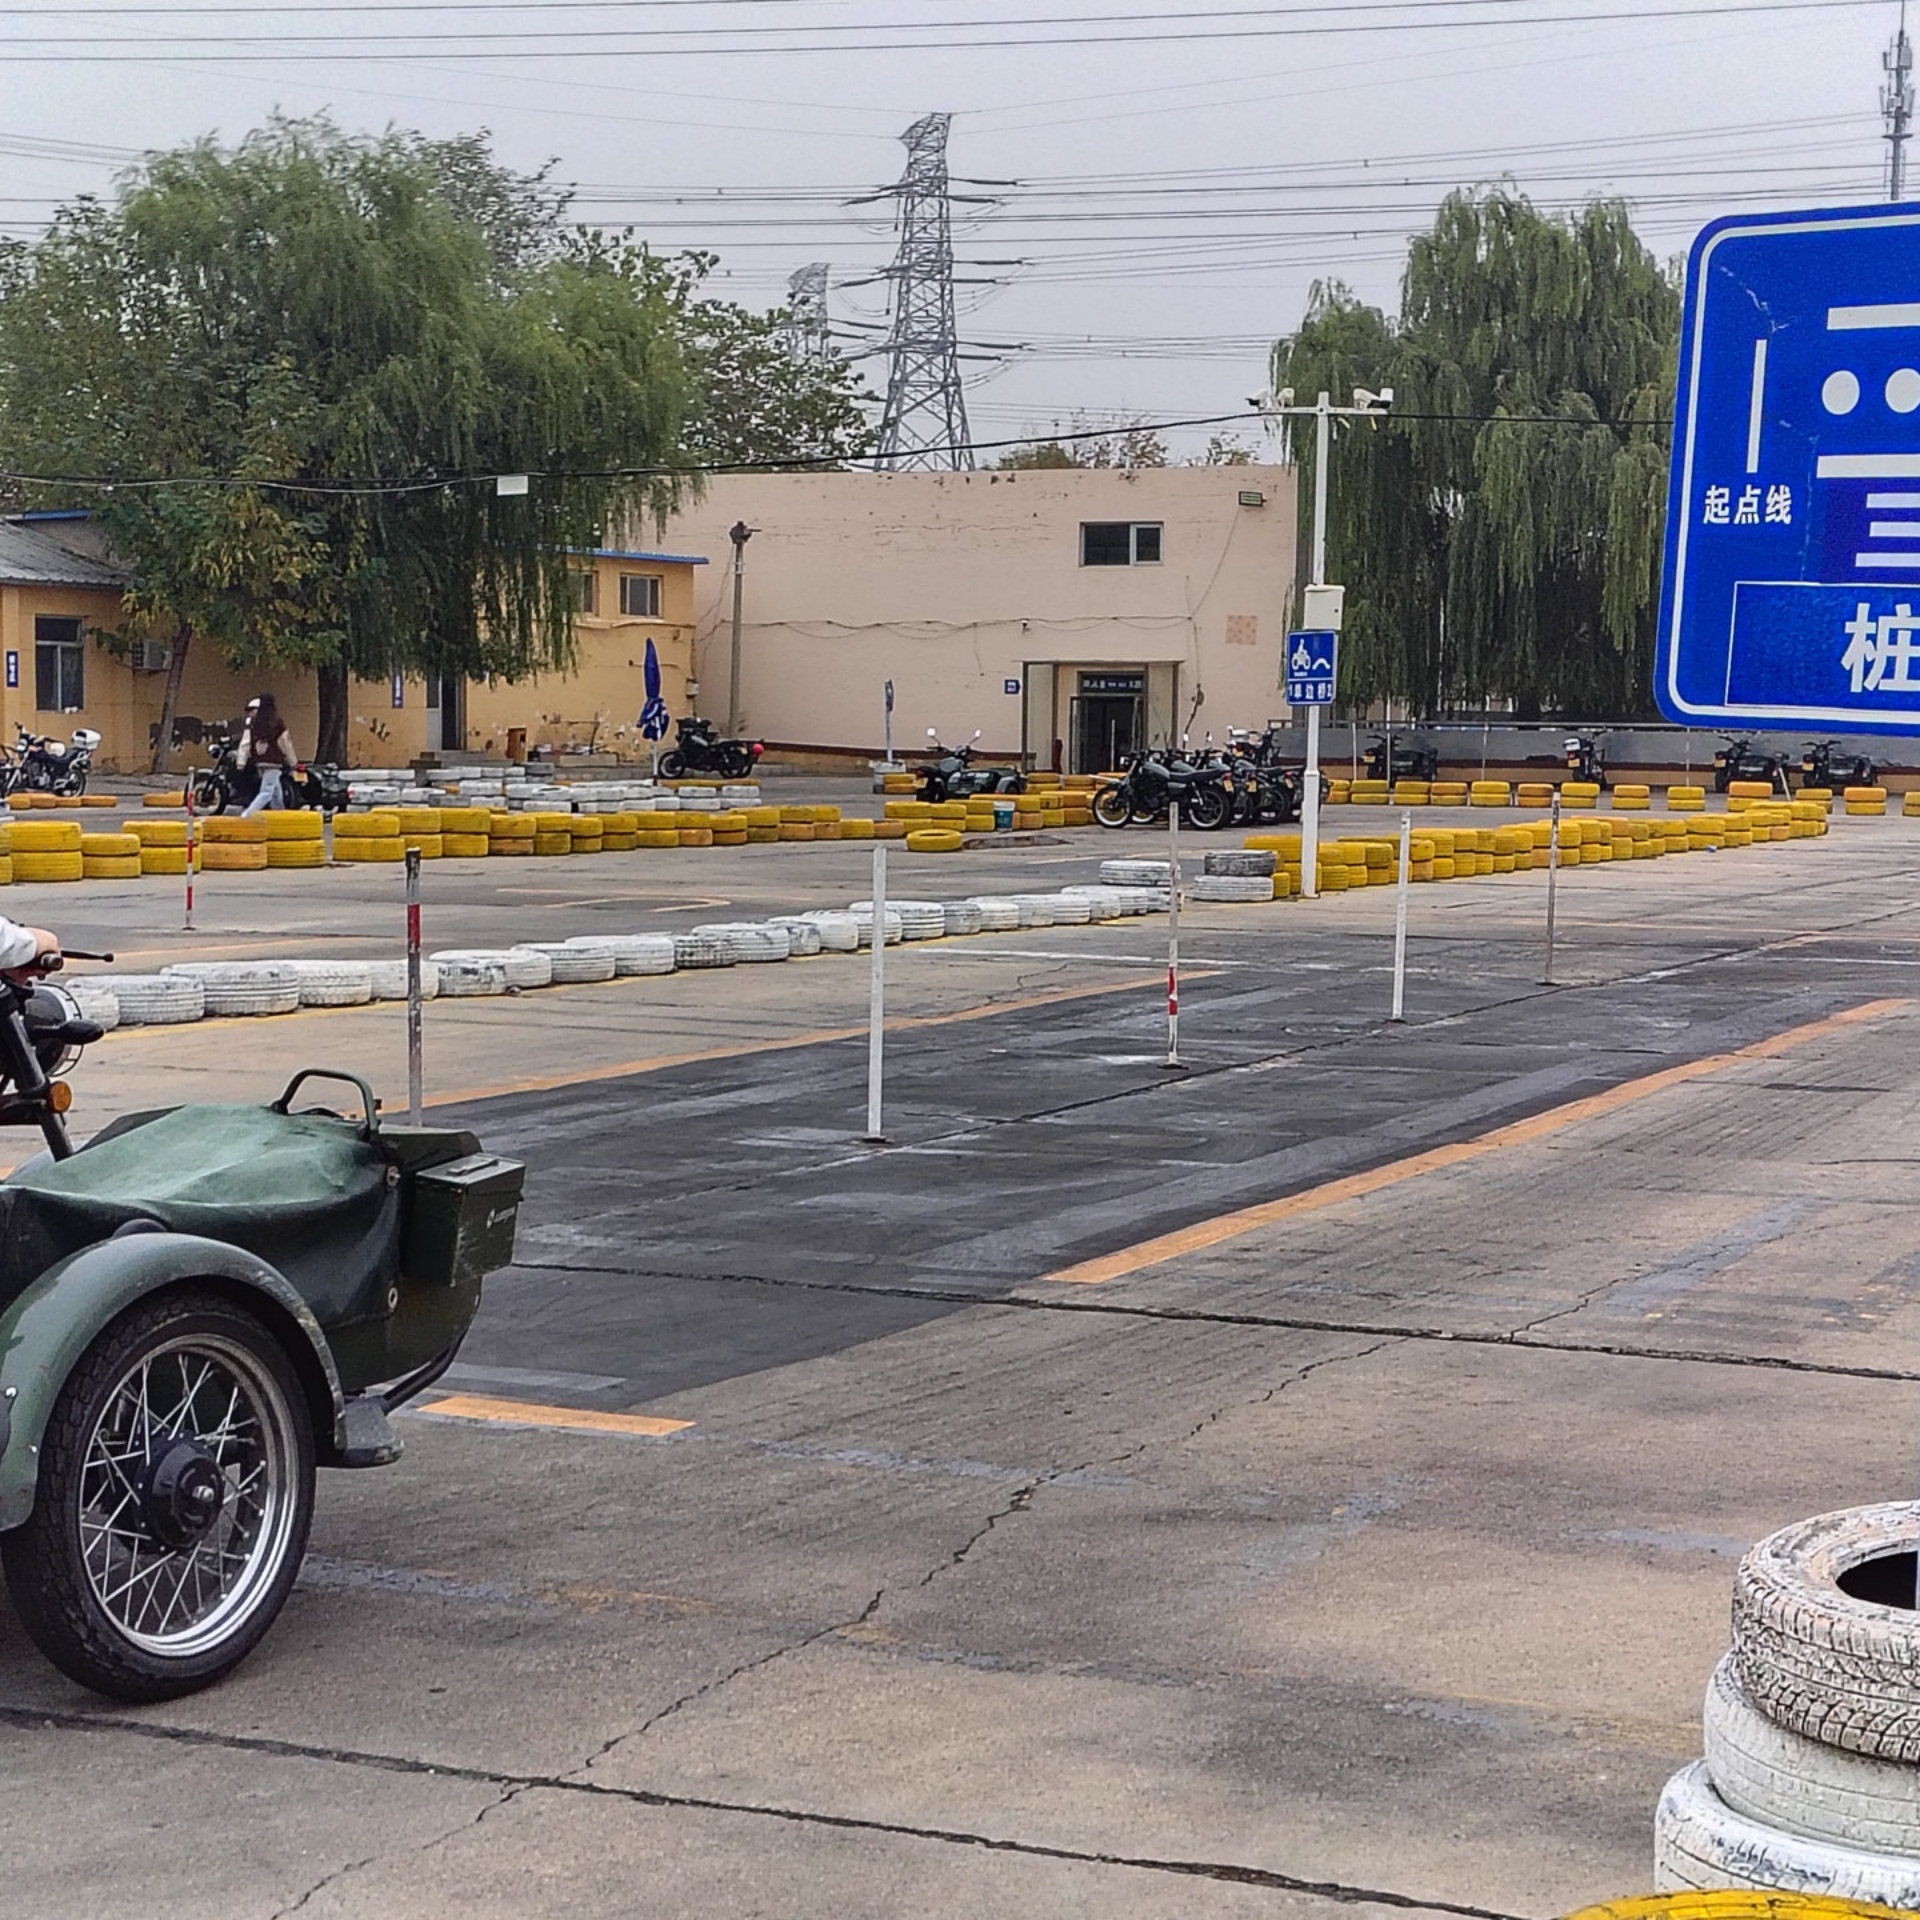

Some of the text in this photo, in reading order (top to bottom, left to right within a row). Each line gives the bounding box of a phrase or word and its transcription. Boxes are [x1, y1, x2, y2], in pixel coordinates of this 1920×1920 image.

[1703, 484, 1792, 524] 起点线
[1841, 602, 1920, 692] 桩
